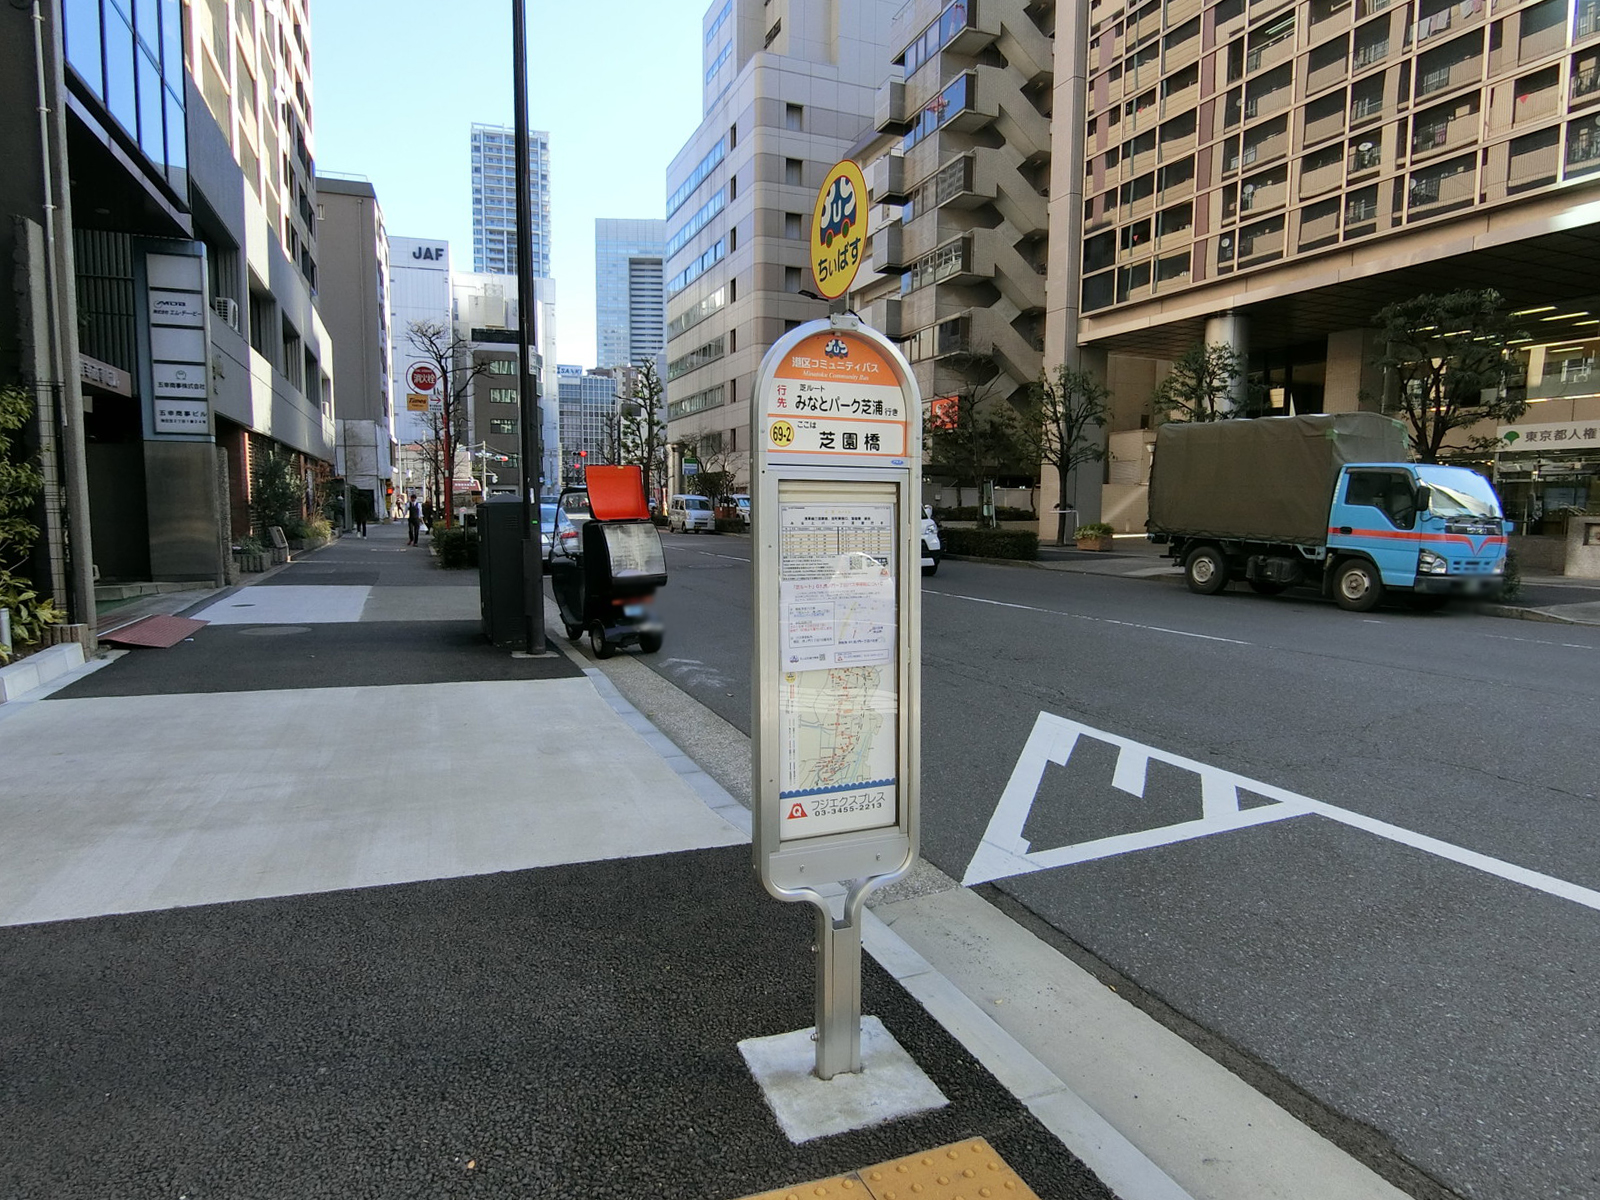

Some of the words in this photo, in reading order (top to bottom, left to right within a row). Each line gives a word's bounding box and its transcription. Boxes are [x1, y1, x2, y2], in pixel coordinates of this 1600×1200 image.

[412, 246, 444, 261] JAF
[818, 237, 861, 282] ちいばす
[792, 356, 879, 373] 港区コミュニティバス
[413, 373, 436, 384] 消火栓
[777, 384, 787, 408] 行先
[799, 383, 826, 393] 芝ルート
[797, 420, 817, 429] ここは
[772, 426, 792, 442] 69-2
[819, 431, 880, 451] 芝園橋
[811, 791, 886, 811] フジエクスプレス
[815, 802, 882, 817] 03-3455-2213
